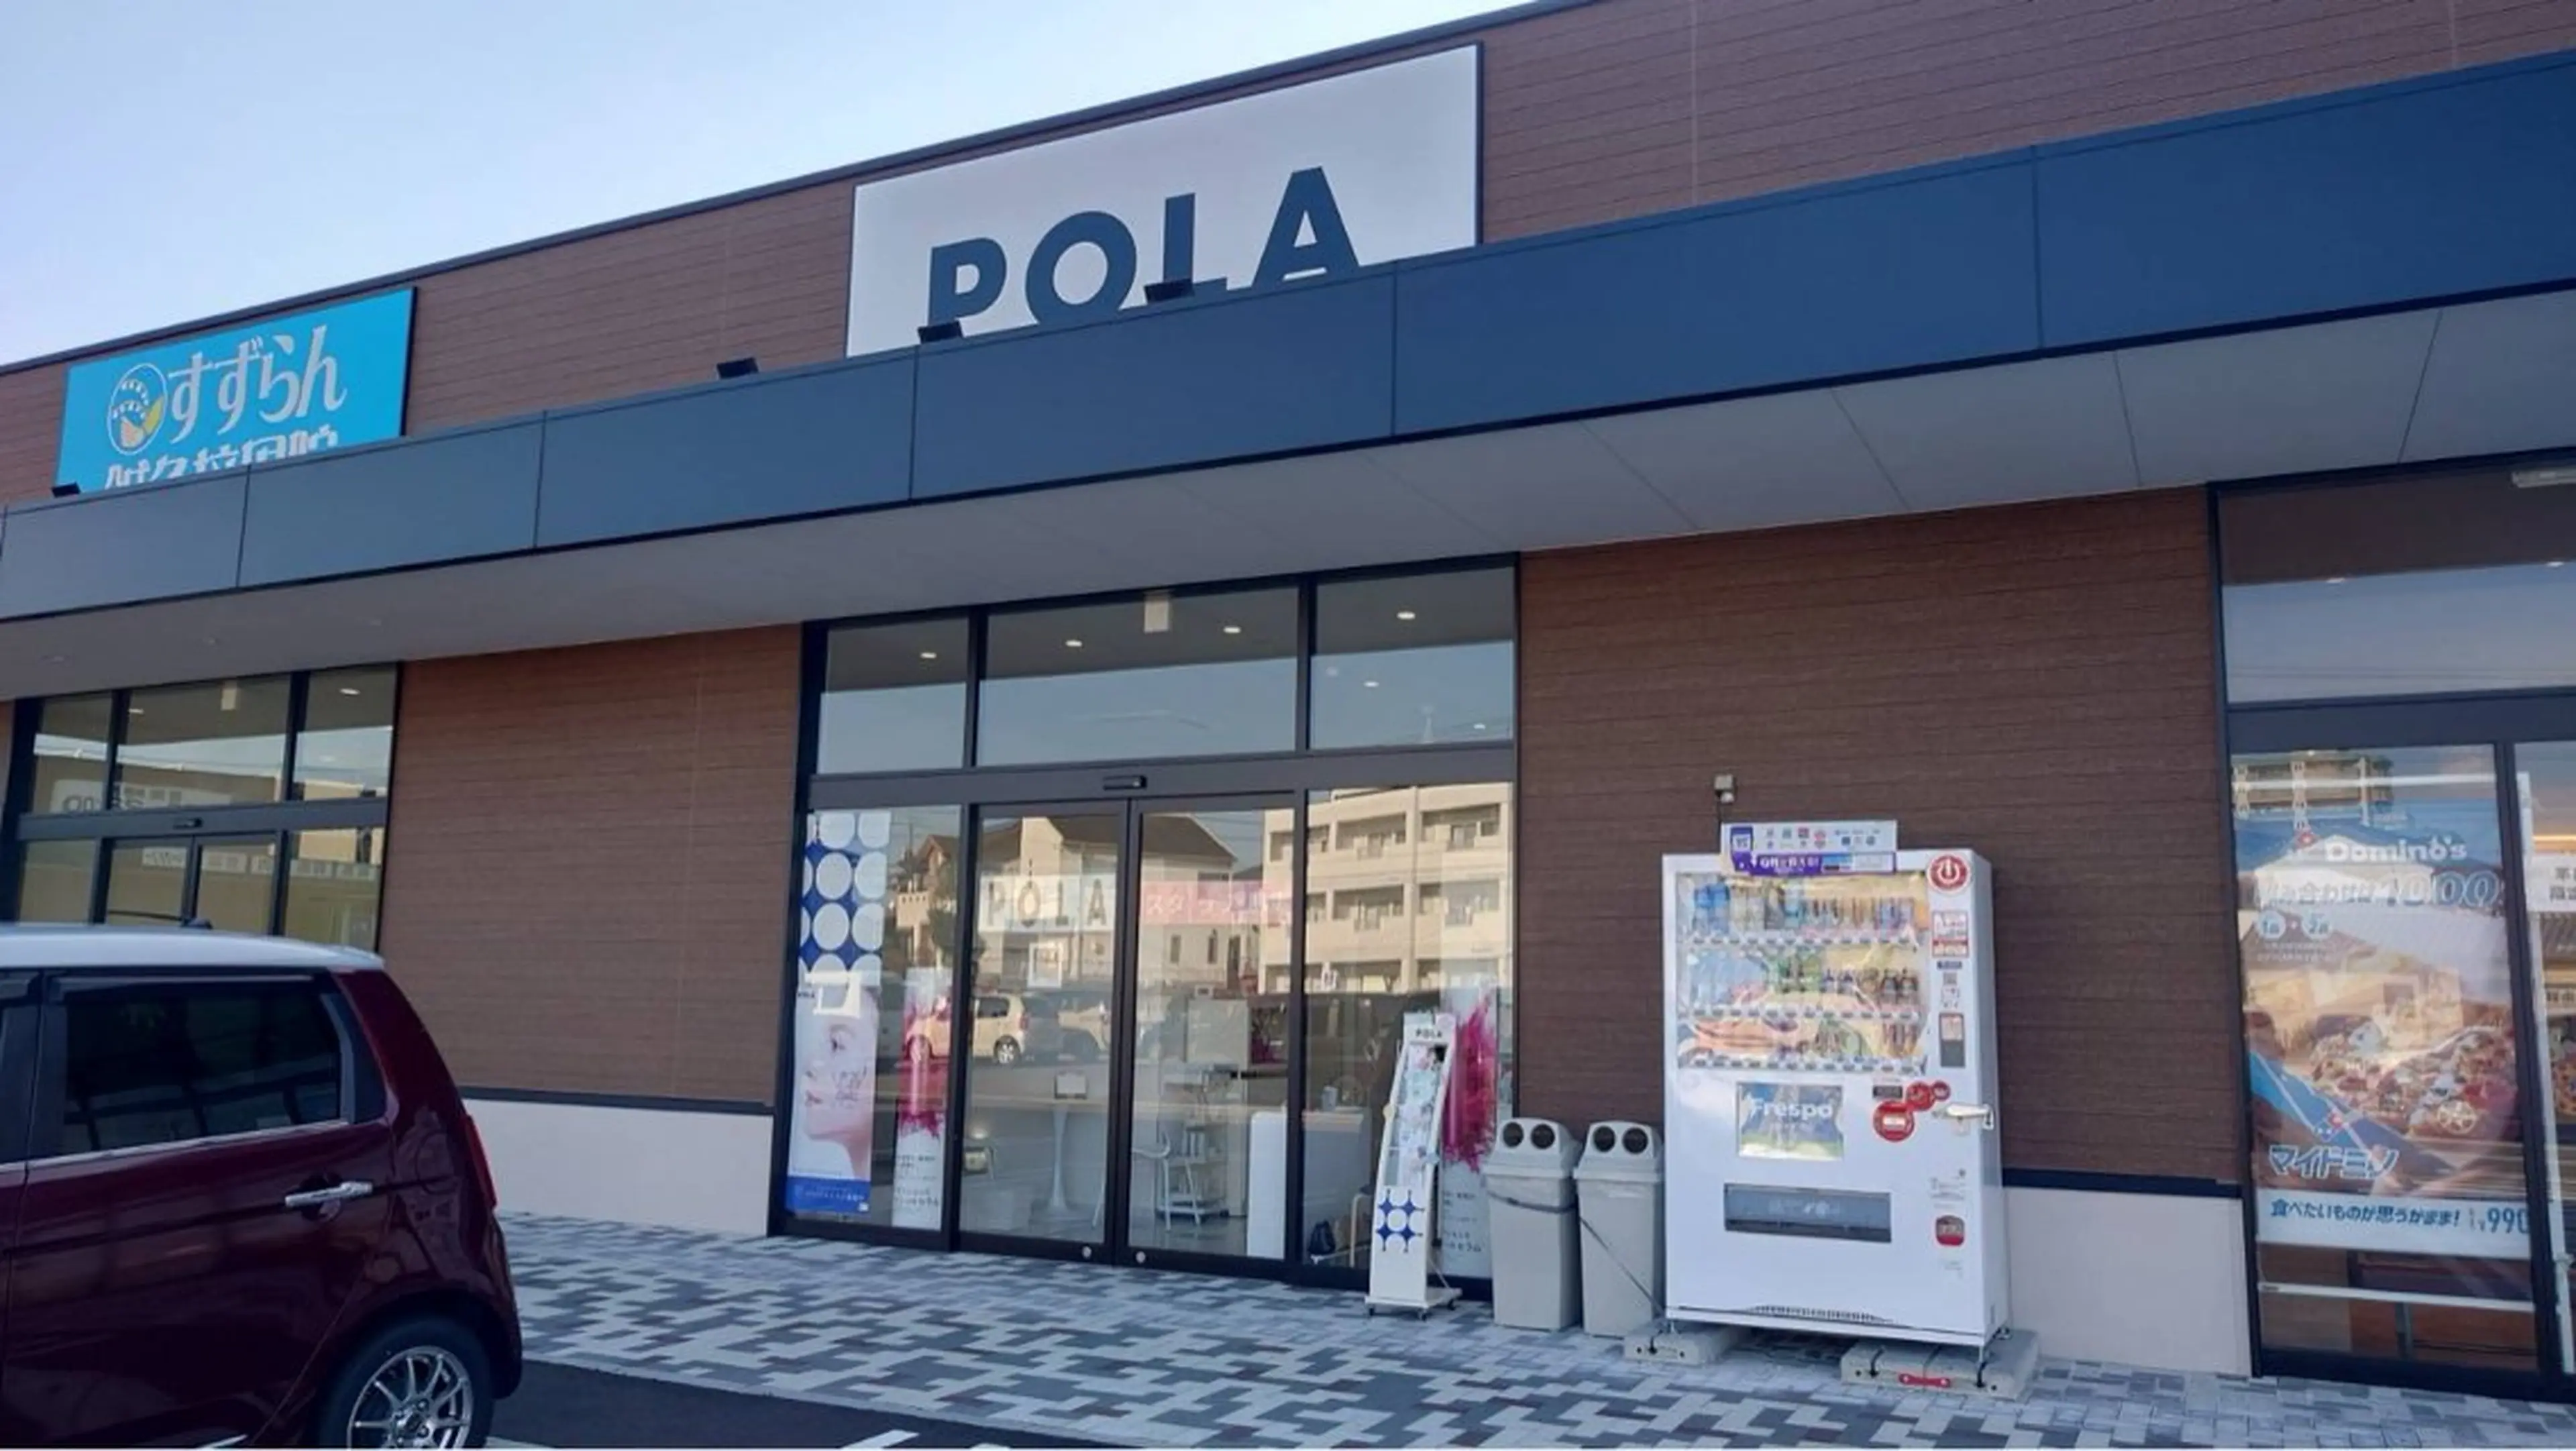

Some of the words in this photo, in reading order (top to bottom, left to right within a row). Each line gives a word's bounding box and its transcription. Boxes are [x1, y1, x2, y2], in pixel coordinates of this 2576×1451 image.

[928, 166, 1360, 326] POLA
[168, 324, 347, 444] すずらん
[2324, 835, 2468, 863] Domino's
[987, 878, 1108, 927] POLA
[1746, 1093, 1833, 1121] Frespo
